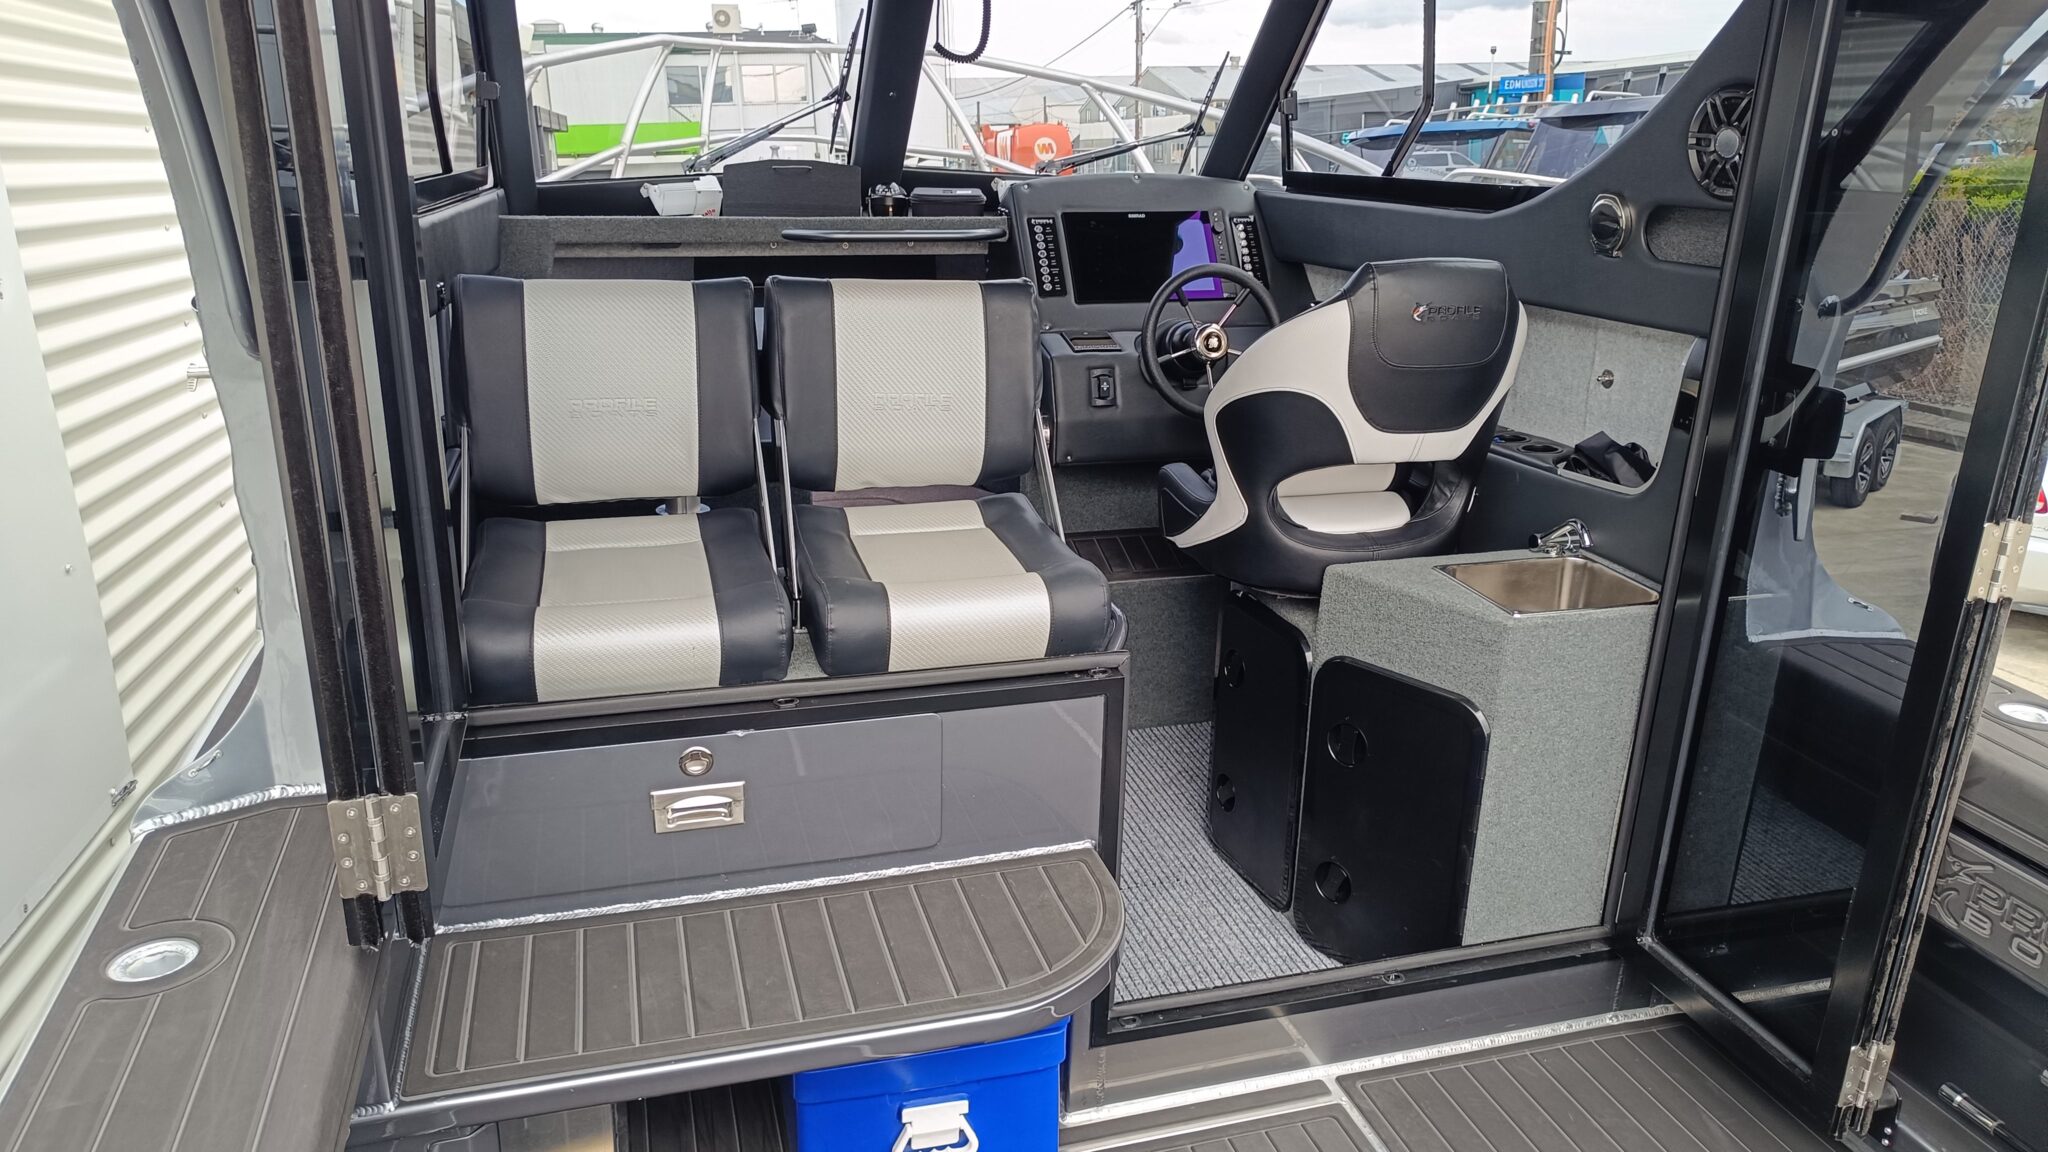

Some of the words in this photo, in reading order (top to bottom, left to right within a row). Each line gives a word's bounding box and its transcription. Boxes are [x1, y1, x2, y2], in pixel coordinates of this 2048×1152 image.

[1428, 304, 1482, 316] PROFILE
[567, 397, 658, 410] PROFILE
[872, 392, 952, 405] PROFILE
